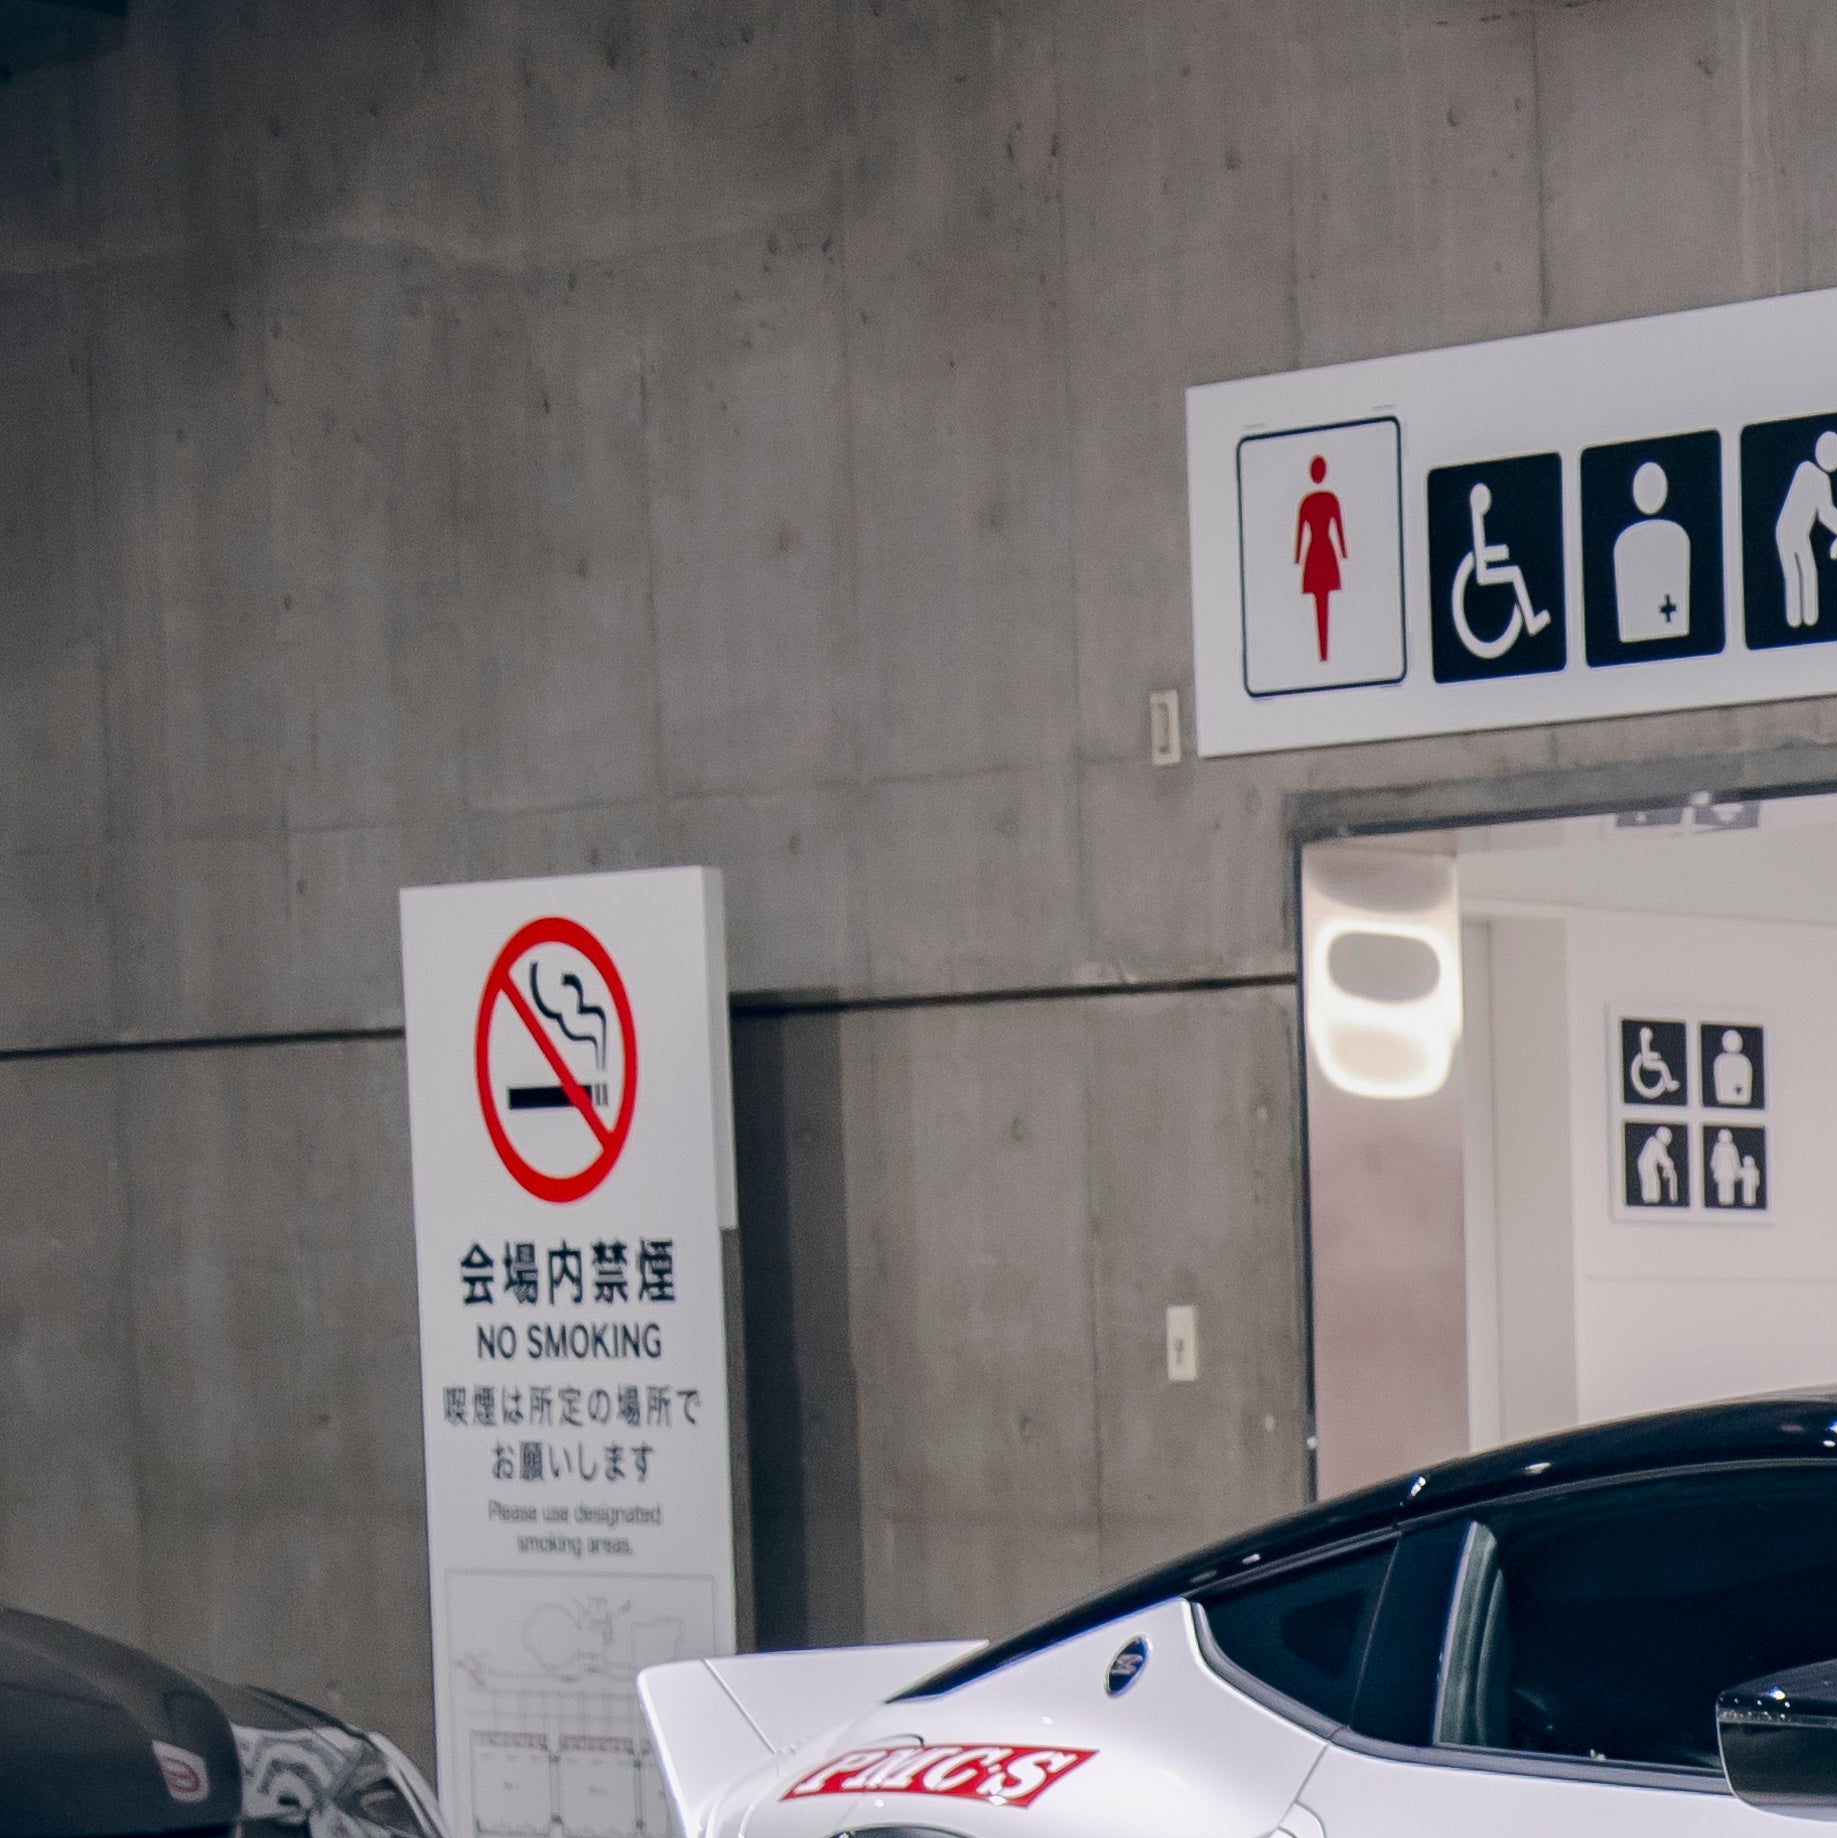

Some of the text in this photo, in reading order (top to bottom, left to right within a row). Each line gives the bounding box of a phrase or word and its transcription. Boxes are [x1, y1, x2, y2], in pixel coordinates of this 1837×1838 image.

[460, 1240, 676, 1305] 会場内禁煙
[477, 1323, 663, 1359] NO SMOKING
[444, 1385, 701, 1427] 喫煙は所定の場所で
[492, 1441, 654, 1482] お願いします
[488, 1500, 662, 1527] Please use designated
[517, 1534, 583, 1559] smoking
